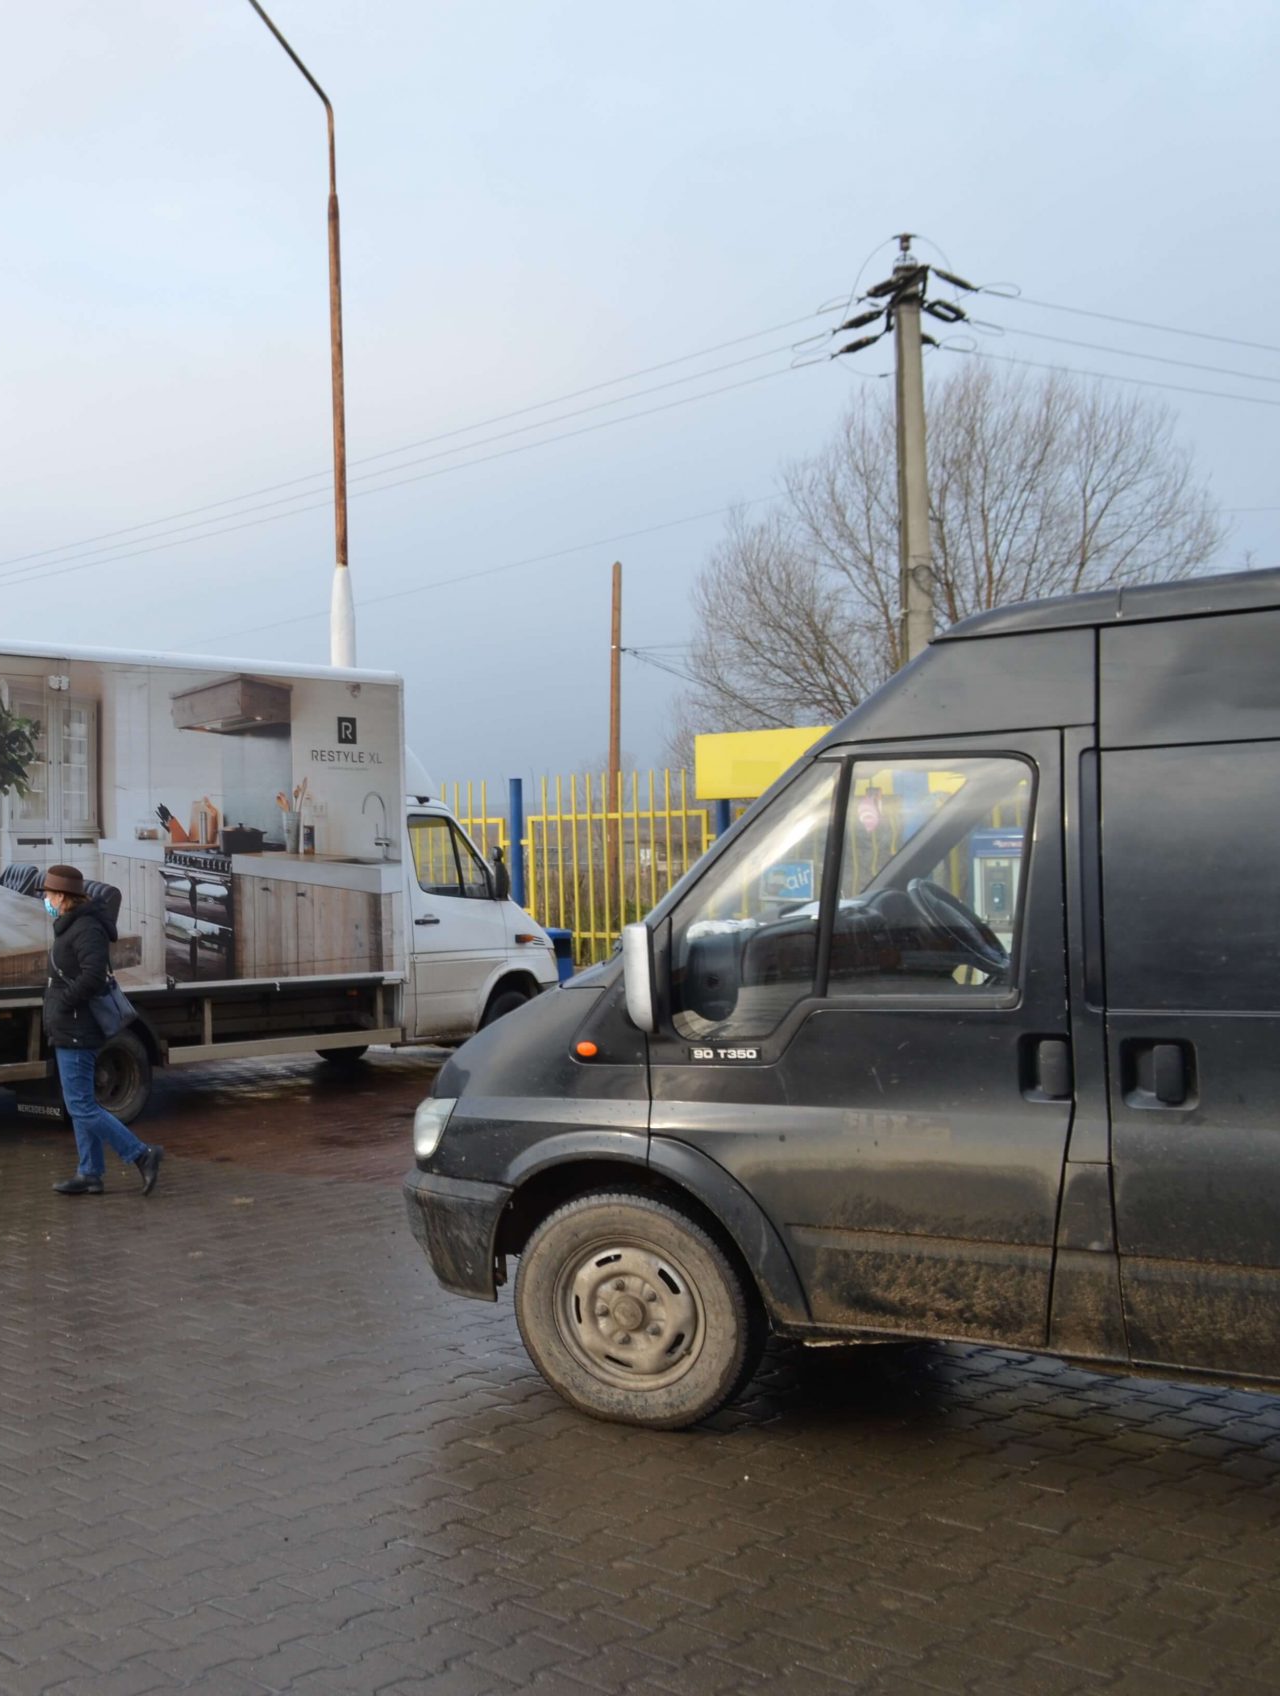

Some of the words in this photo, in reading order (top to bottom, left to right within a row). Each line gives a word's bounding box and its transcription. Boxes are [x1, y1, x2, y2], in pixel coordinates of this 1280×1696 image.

[341, 721, 353, 739] R
[311, 750, 365, 763] RESTYLE
[369, 752, 383, 764] XL
[693, 1049, 714, 1059] 90
[717, 1049, 757, 1059] T350
